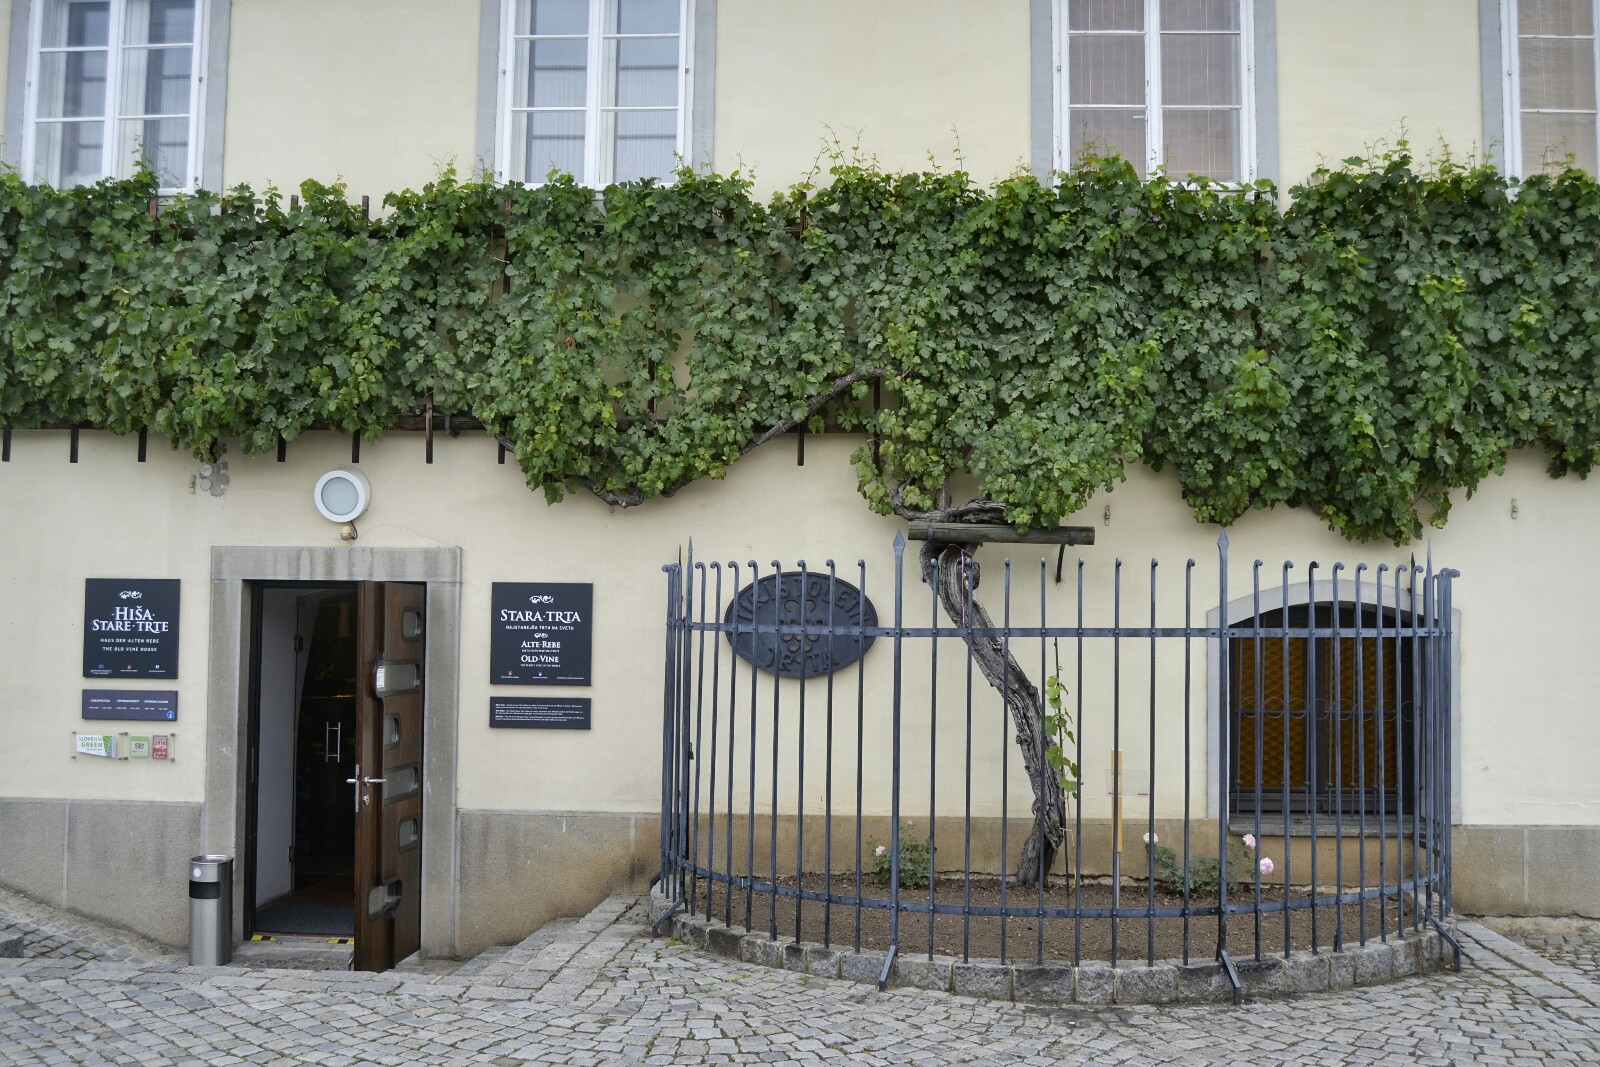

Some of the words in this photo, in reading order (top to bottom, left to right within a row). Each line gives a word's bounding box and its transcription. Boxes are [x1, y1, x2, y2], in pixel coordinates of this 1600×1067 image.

[500, 608, 543, 622] STARA
[545, 611, 582, 624] TRTA
[92, 619, 131, 631] STARE
[136, 621, 169, 634] TRTE
[520, 640, 540, 648] ALTE
[541, 640, 561, 649] REBE
[520, 654, 538, 663] OLD
[540, 655, 559, 663] VINE
